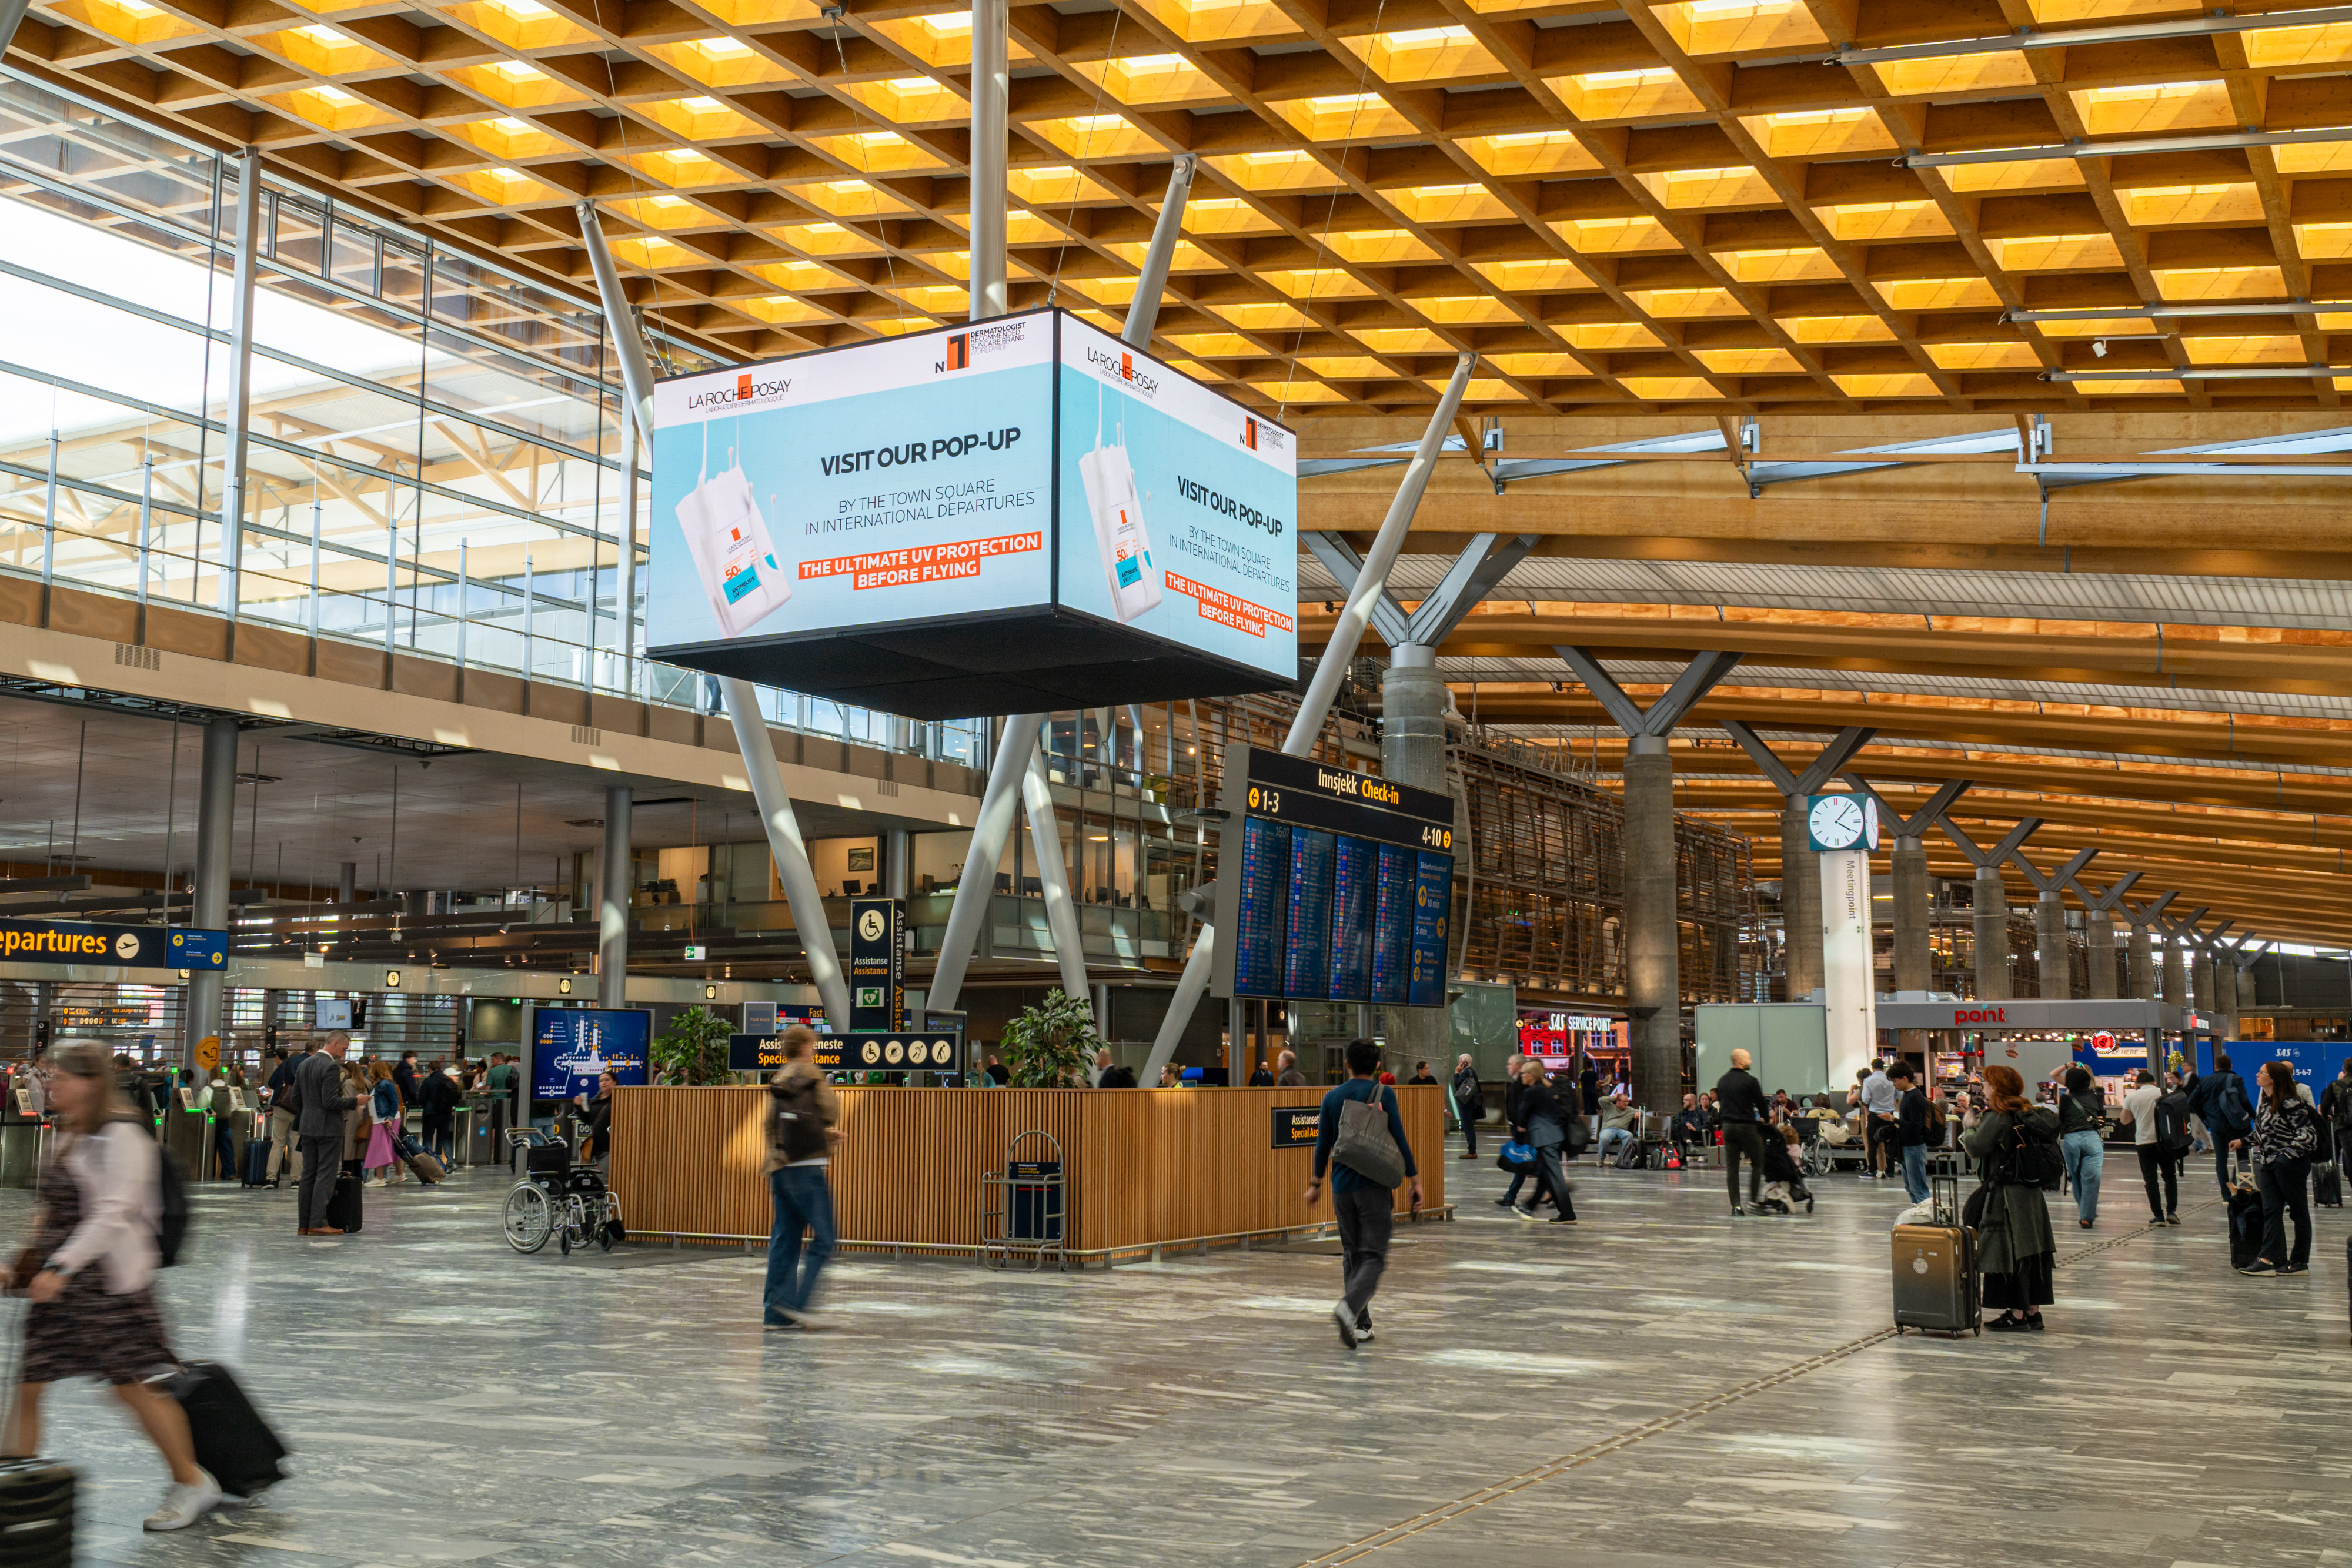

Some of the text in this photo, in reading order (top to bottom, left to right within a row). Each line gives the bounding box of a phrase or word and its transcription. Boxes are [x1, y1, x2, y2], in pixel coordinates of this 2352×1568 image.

[971, 322, 1026, 337] DERMATOLOGIST
[971, 329, 1020, 343] RECOMMENDED
[971, 335, 1024, 350] SUNCARE BRAND
[1088, 347, 1099, 365] LA
[1132, 369, 1158, 394] POSAY
[689, 394, 704, 409] LA
[751, 379, 792, 398] POSAY
[821, 427, 1021, 476] VISIT OUR POP-UP
[839, 479, 995, 513] BY THE TOWN SQUARE
[1177, 475, 1283, 537] VISIT OUR POP-UP
[805, 492, 1035, 535] IN INTERNATIONAL DEPARTURES
[801, 534, 1038, 577] THE ULTIMATE UV PROTECTION
[1189, 525, 1271, 570] BY THE TOWN SQUARE
[725, 566, 741, 580] 50+
[858, 560, 977, 587] BEFORE FLYING
[1169, 534, 1290, 593] IN INTERNATIONAL DEPARTURES
[732, 576, 755, 594] ANTHELIOS
[1167, 574, 1292, 630] THE ULTIMATE UV PROTECTION
[1201, 604, 1264, 636] BEFORE FLYING
[1318, 768, 1399, 804] Innsjekk Check-in
[1262, 790, 1279, 813] 1-3
[1275, 826, 1290, 838] 16:07
[1422, 826, 1441, 847] 4-10
[1846, 860, 1856, 920] Meetingpoint
[1427, 898, 1432, 907] 10
[1416, 926, 1428, 935] 5 min
[896, 910, 904, 979] Assistanse
[854, 957, 888, 966] Assistanse
[854, 967, 888, 975] Assistance
[809, 1008, 823, 1018] Fast
[894, 985, 903, 1032] Assista
[1954, 1004, 2006, 1025] point
[1549, 1013, 1612, 1031] SAS SERVICE POINT
[758, 1052, 789, 1066] Specia
[2275, 1048, 2291, 1057] SAS
[1292, 1114, 1321, 1125] Assistanset
[1291, 1127, 1309, 1141] Special
